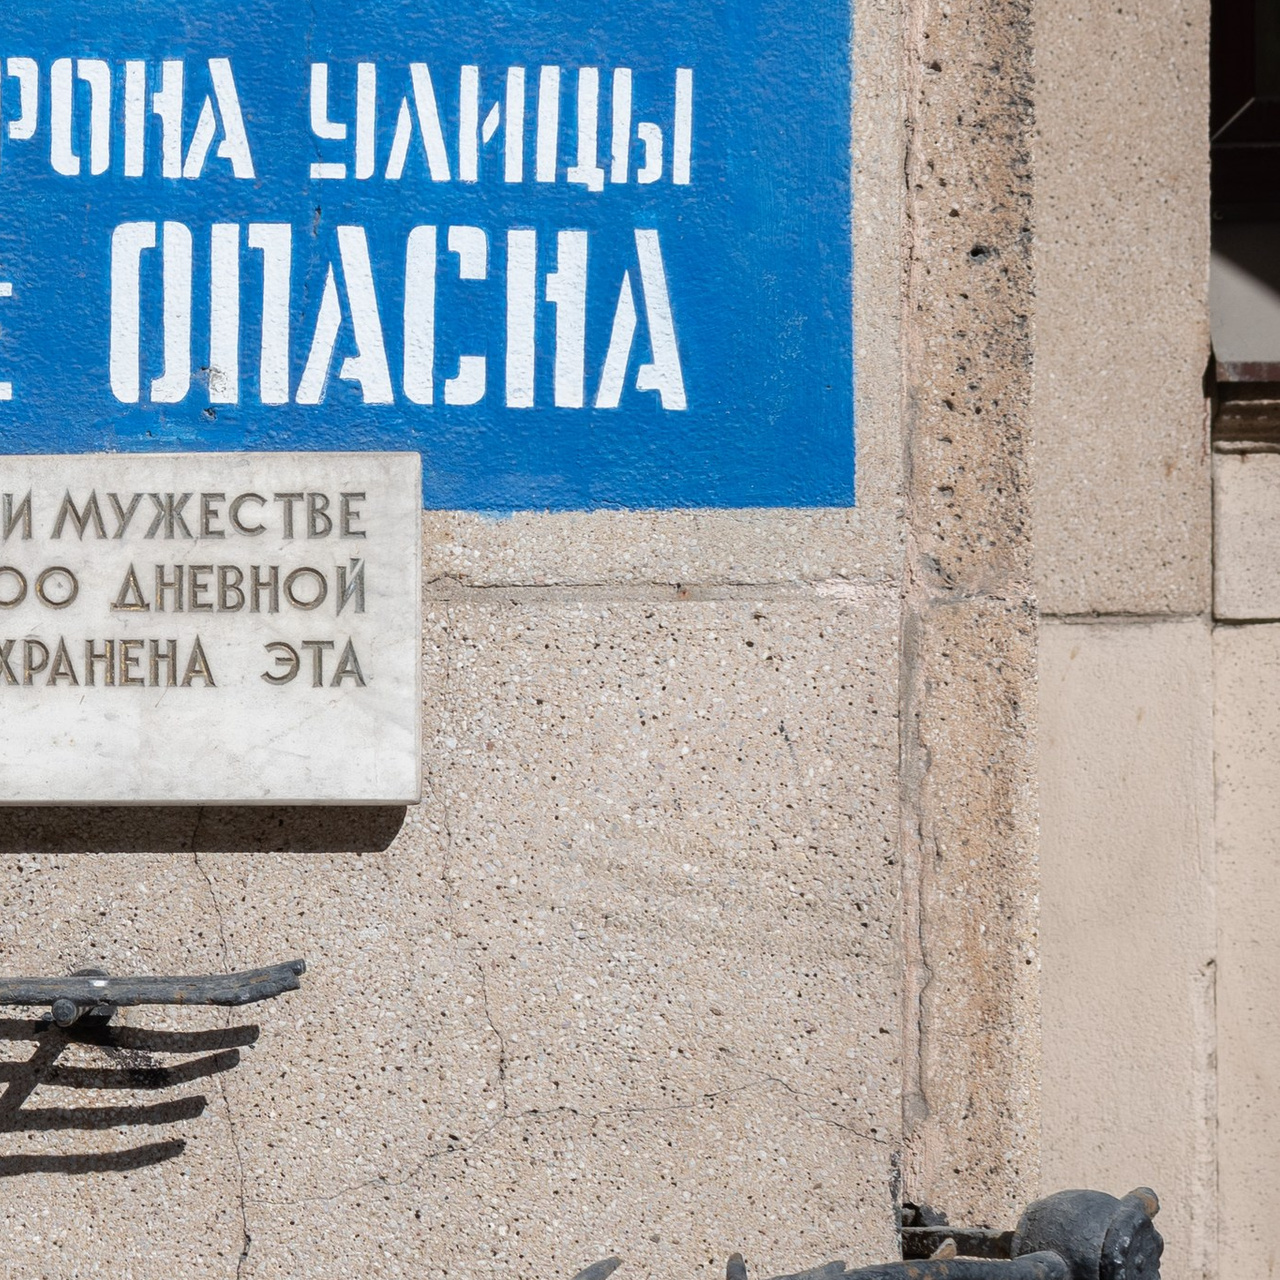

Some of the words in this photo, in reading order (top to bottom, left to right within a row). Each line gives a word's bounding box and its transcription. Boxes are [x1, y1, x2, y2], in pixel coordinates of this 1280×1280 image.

[310, 63, 692, 191] УЛИЦЫ
[110, 221, 686, 410] ОПАСНА
[3, 489, 32, 542] И
[51, 489, 366, 541] МУЖЕСТВЕ
[110, 558, 365, 616] ДНЕВНОЙ
[261, 637, 366, 687] ЭТА
